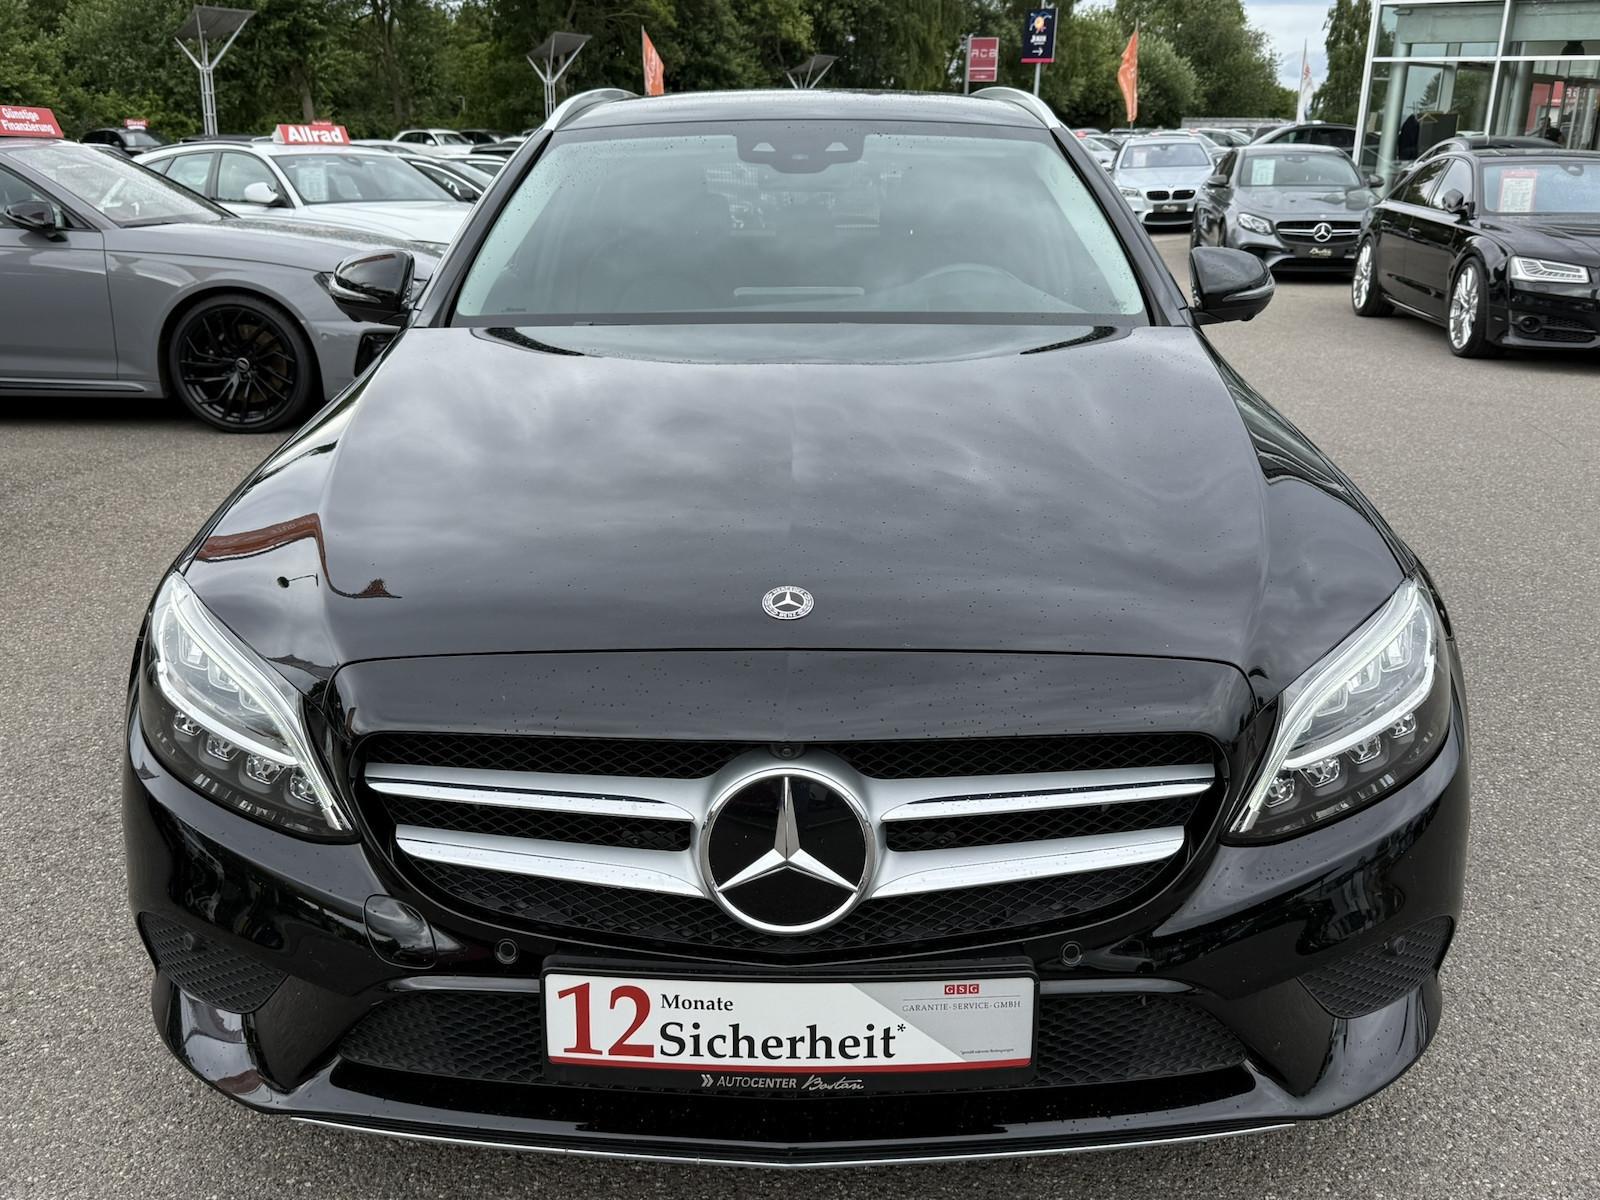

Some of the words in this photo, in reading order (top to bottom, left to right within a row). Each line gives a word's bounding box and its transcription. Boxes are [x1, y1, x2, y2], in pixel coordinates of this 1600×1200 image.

[2, 107, 40, 122] Günstige
[1, 119, 56, 134] Finanzierung
[287, 125, 344, 143] Allrad
[944, 983, 980, 995] GSG
[557, 982, 655, 1058] 12
[660, 993, 734, 1012] Monate
[716, 1075, 798, 1089] AUTOCENTER
